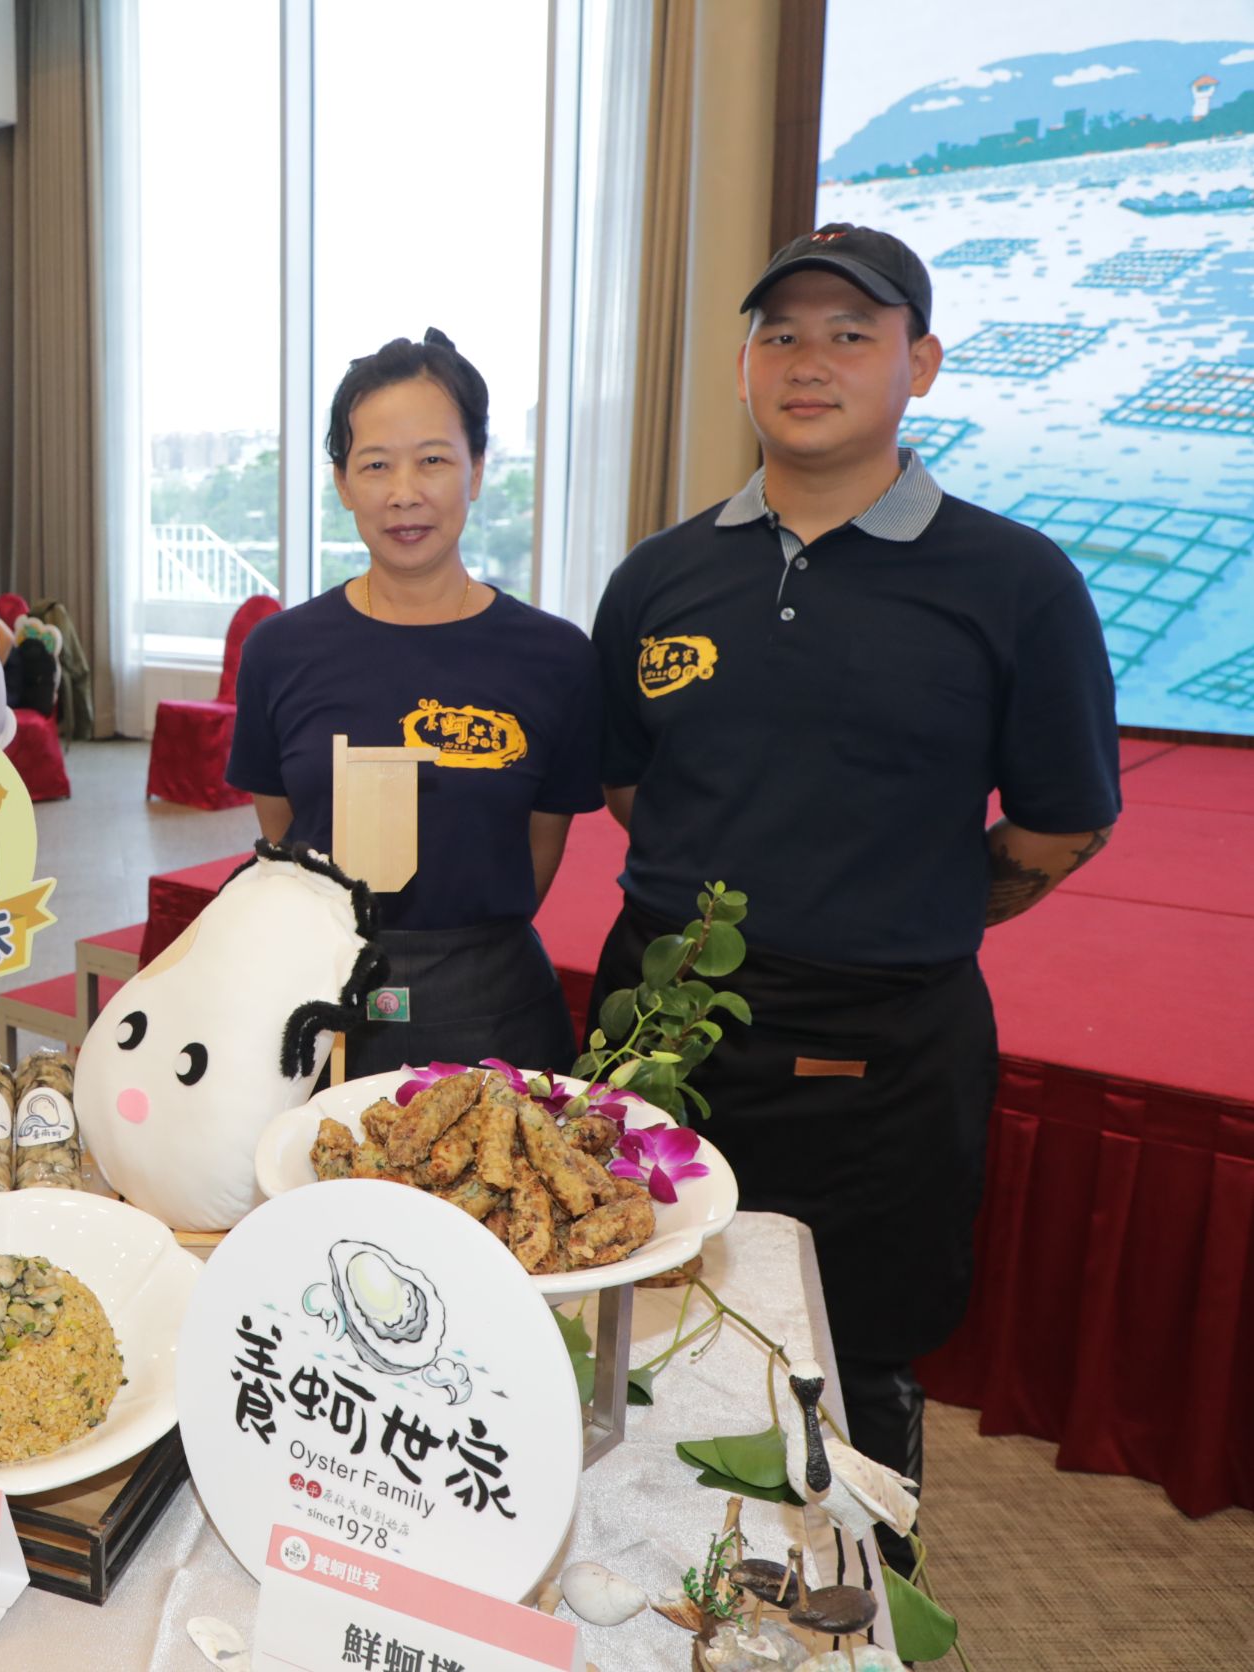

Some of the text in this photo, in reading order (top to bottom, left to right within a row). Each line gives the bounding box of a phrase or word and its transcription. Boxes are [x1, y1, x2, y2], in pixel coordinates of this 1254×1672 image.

[230, 1315, 517, 1520] 養蚵世家
[289, 1440, 436, 1519] Oyster Family
[337, 1514, 388, 1549] 1978
[313, 1552, 381, 1592] 養蚵世家
